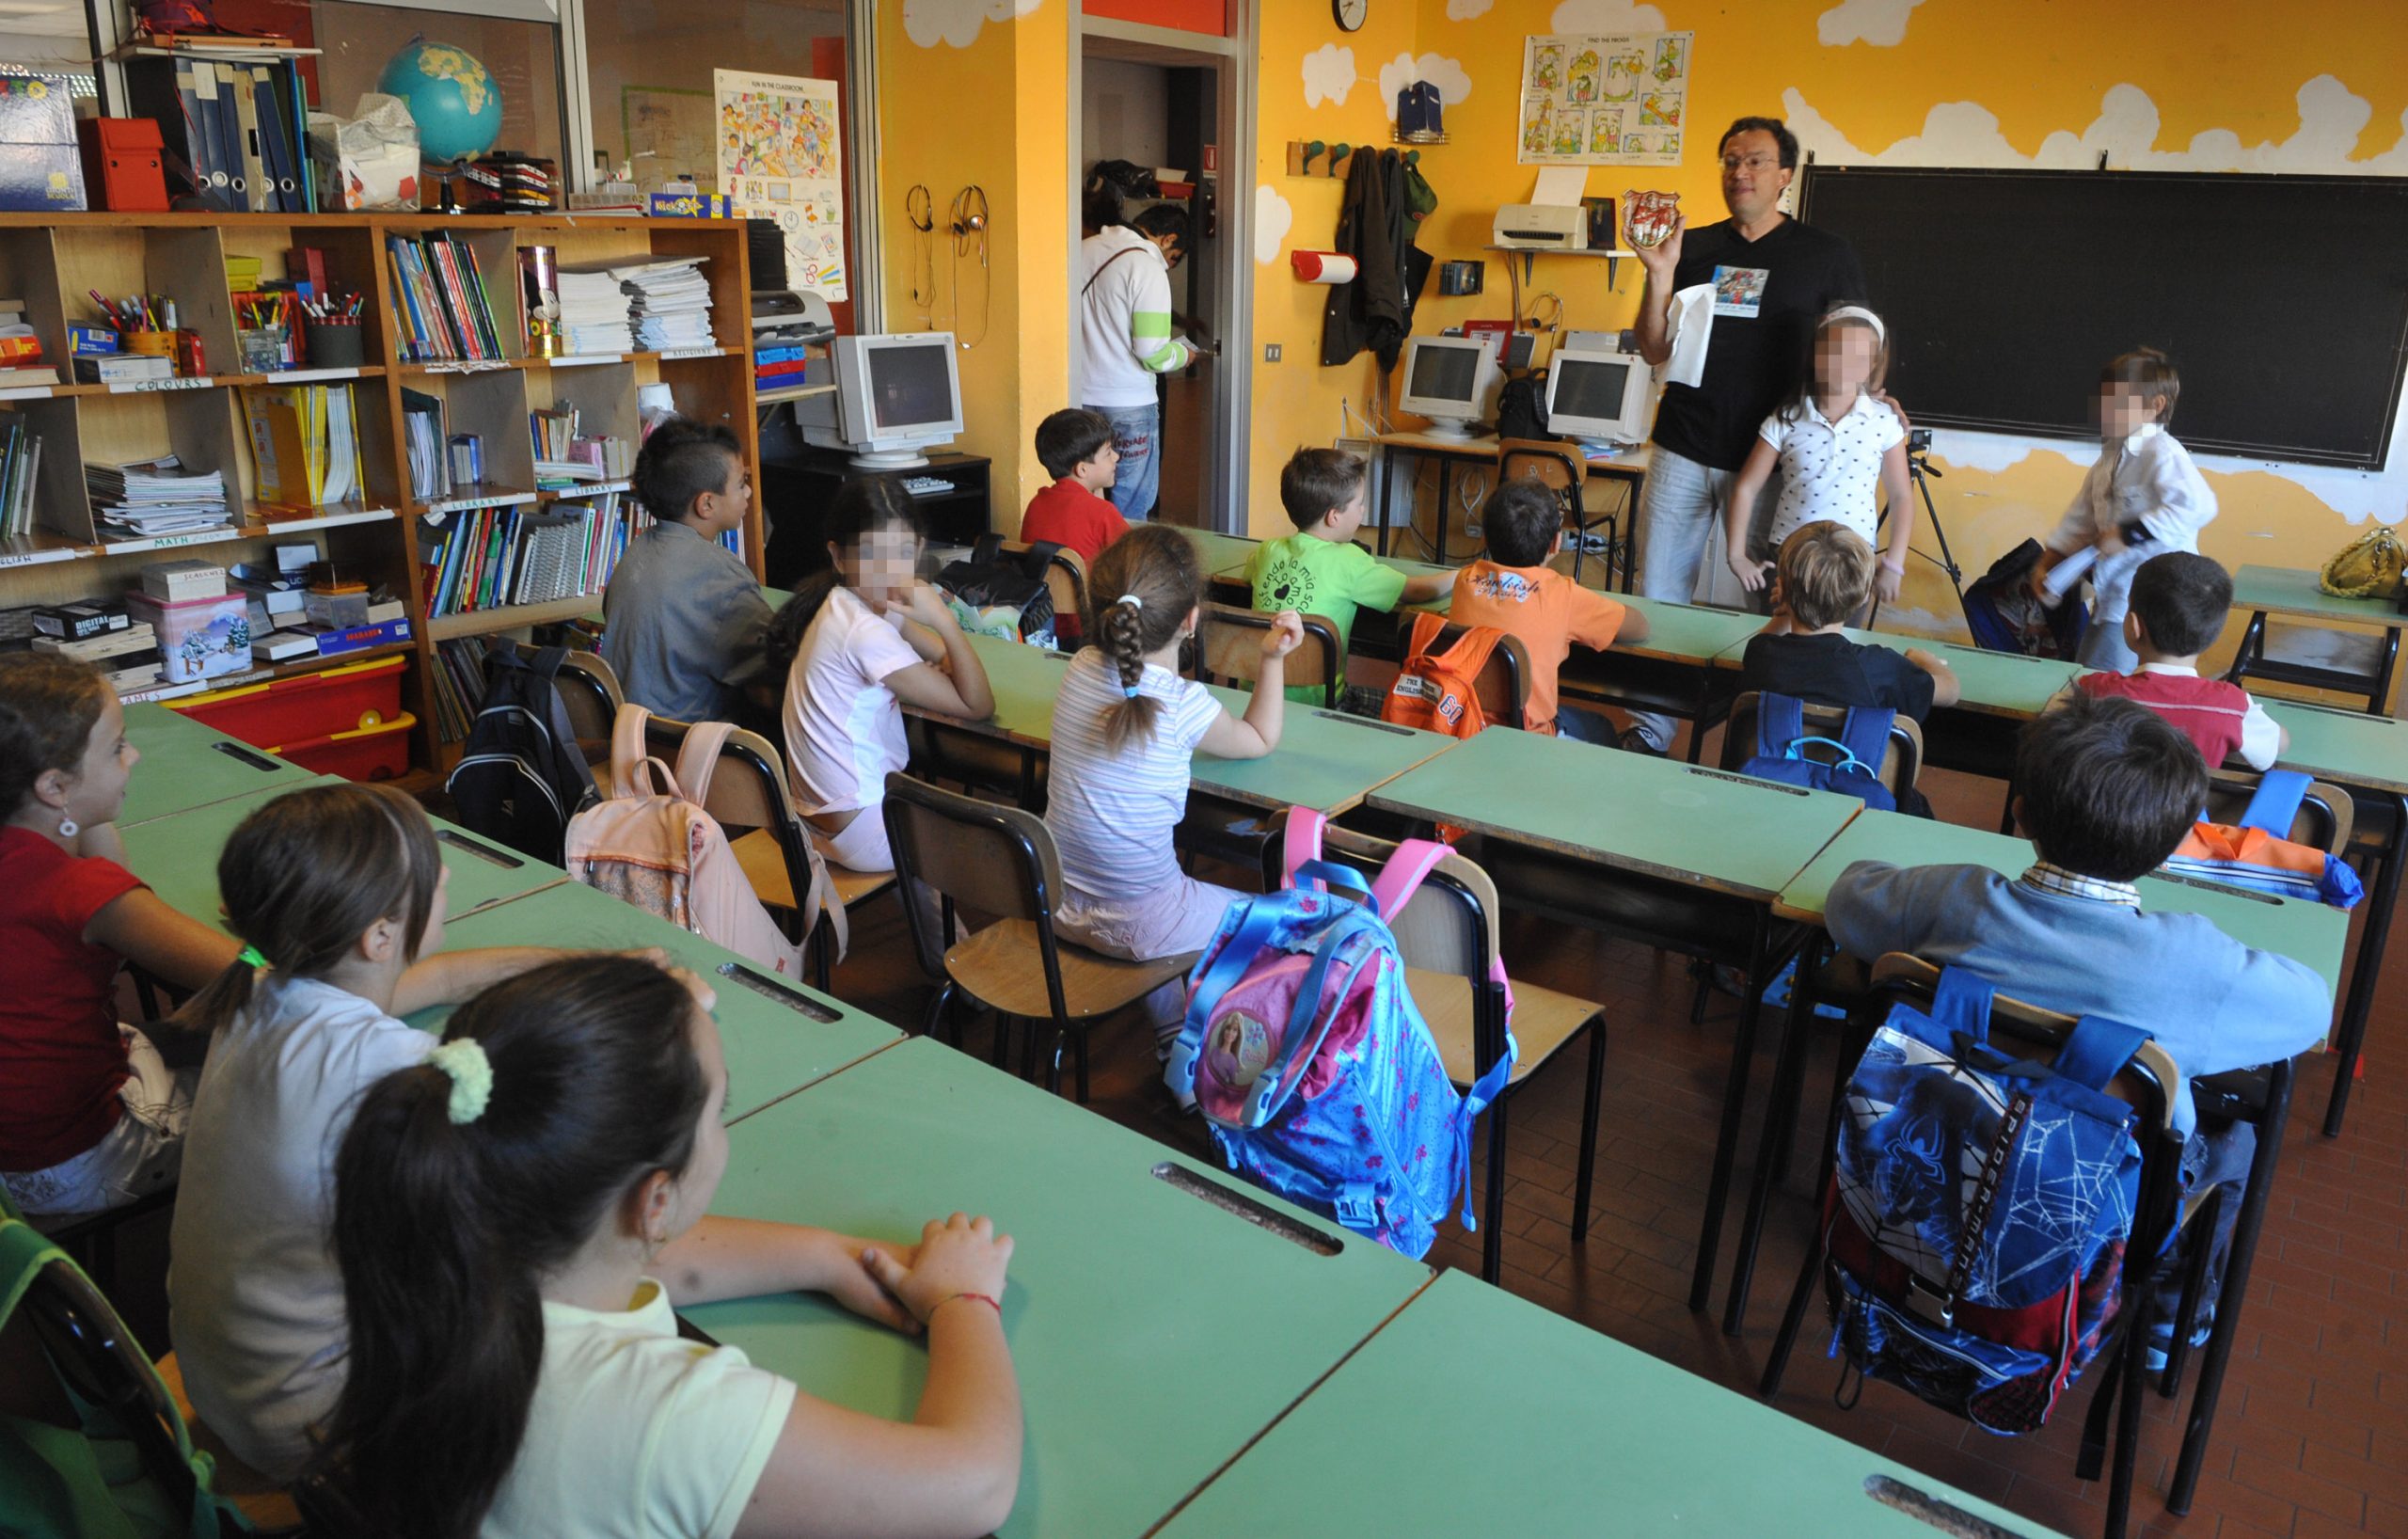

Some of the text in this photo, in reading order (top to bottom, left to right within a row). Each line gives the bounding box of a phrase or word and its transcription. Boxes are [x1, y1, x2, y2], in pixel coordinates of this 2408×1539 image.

[775, 83, 804, 91] CLASSROOM
[135, 377, 202, 391] COLOURS
[575, 484, 613, 496] LIBRARY
[452, 497, 501, 509] LIBRARY
[153, 536, 189, 547] MATH
[1288, 556, 1299, 570] la
[1259, 560, 1285, 609] difendo
[1299, 566, 1317, 590] mia
[1286, 577, 1301, 606] amo
[75, 615, 110, 630] DIGITAL
[121, 691, 161, 706] AMES
[1439, 694, 1465, 726] 60
